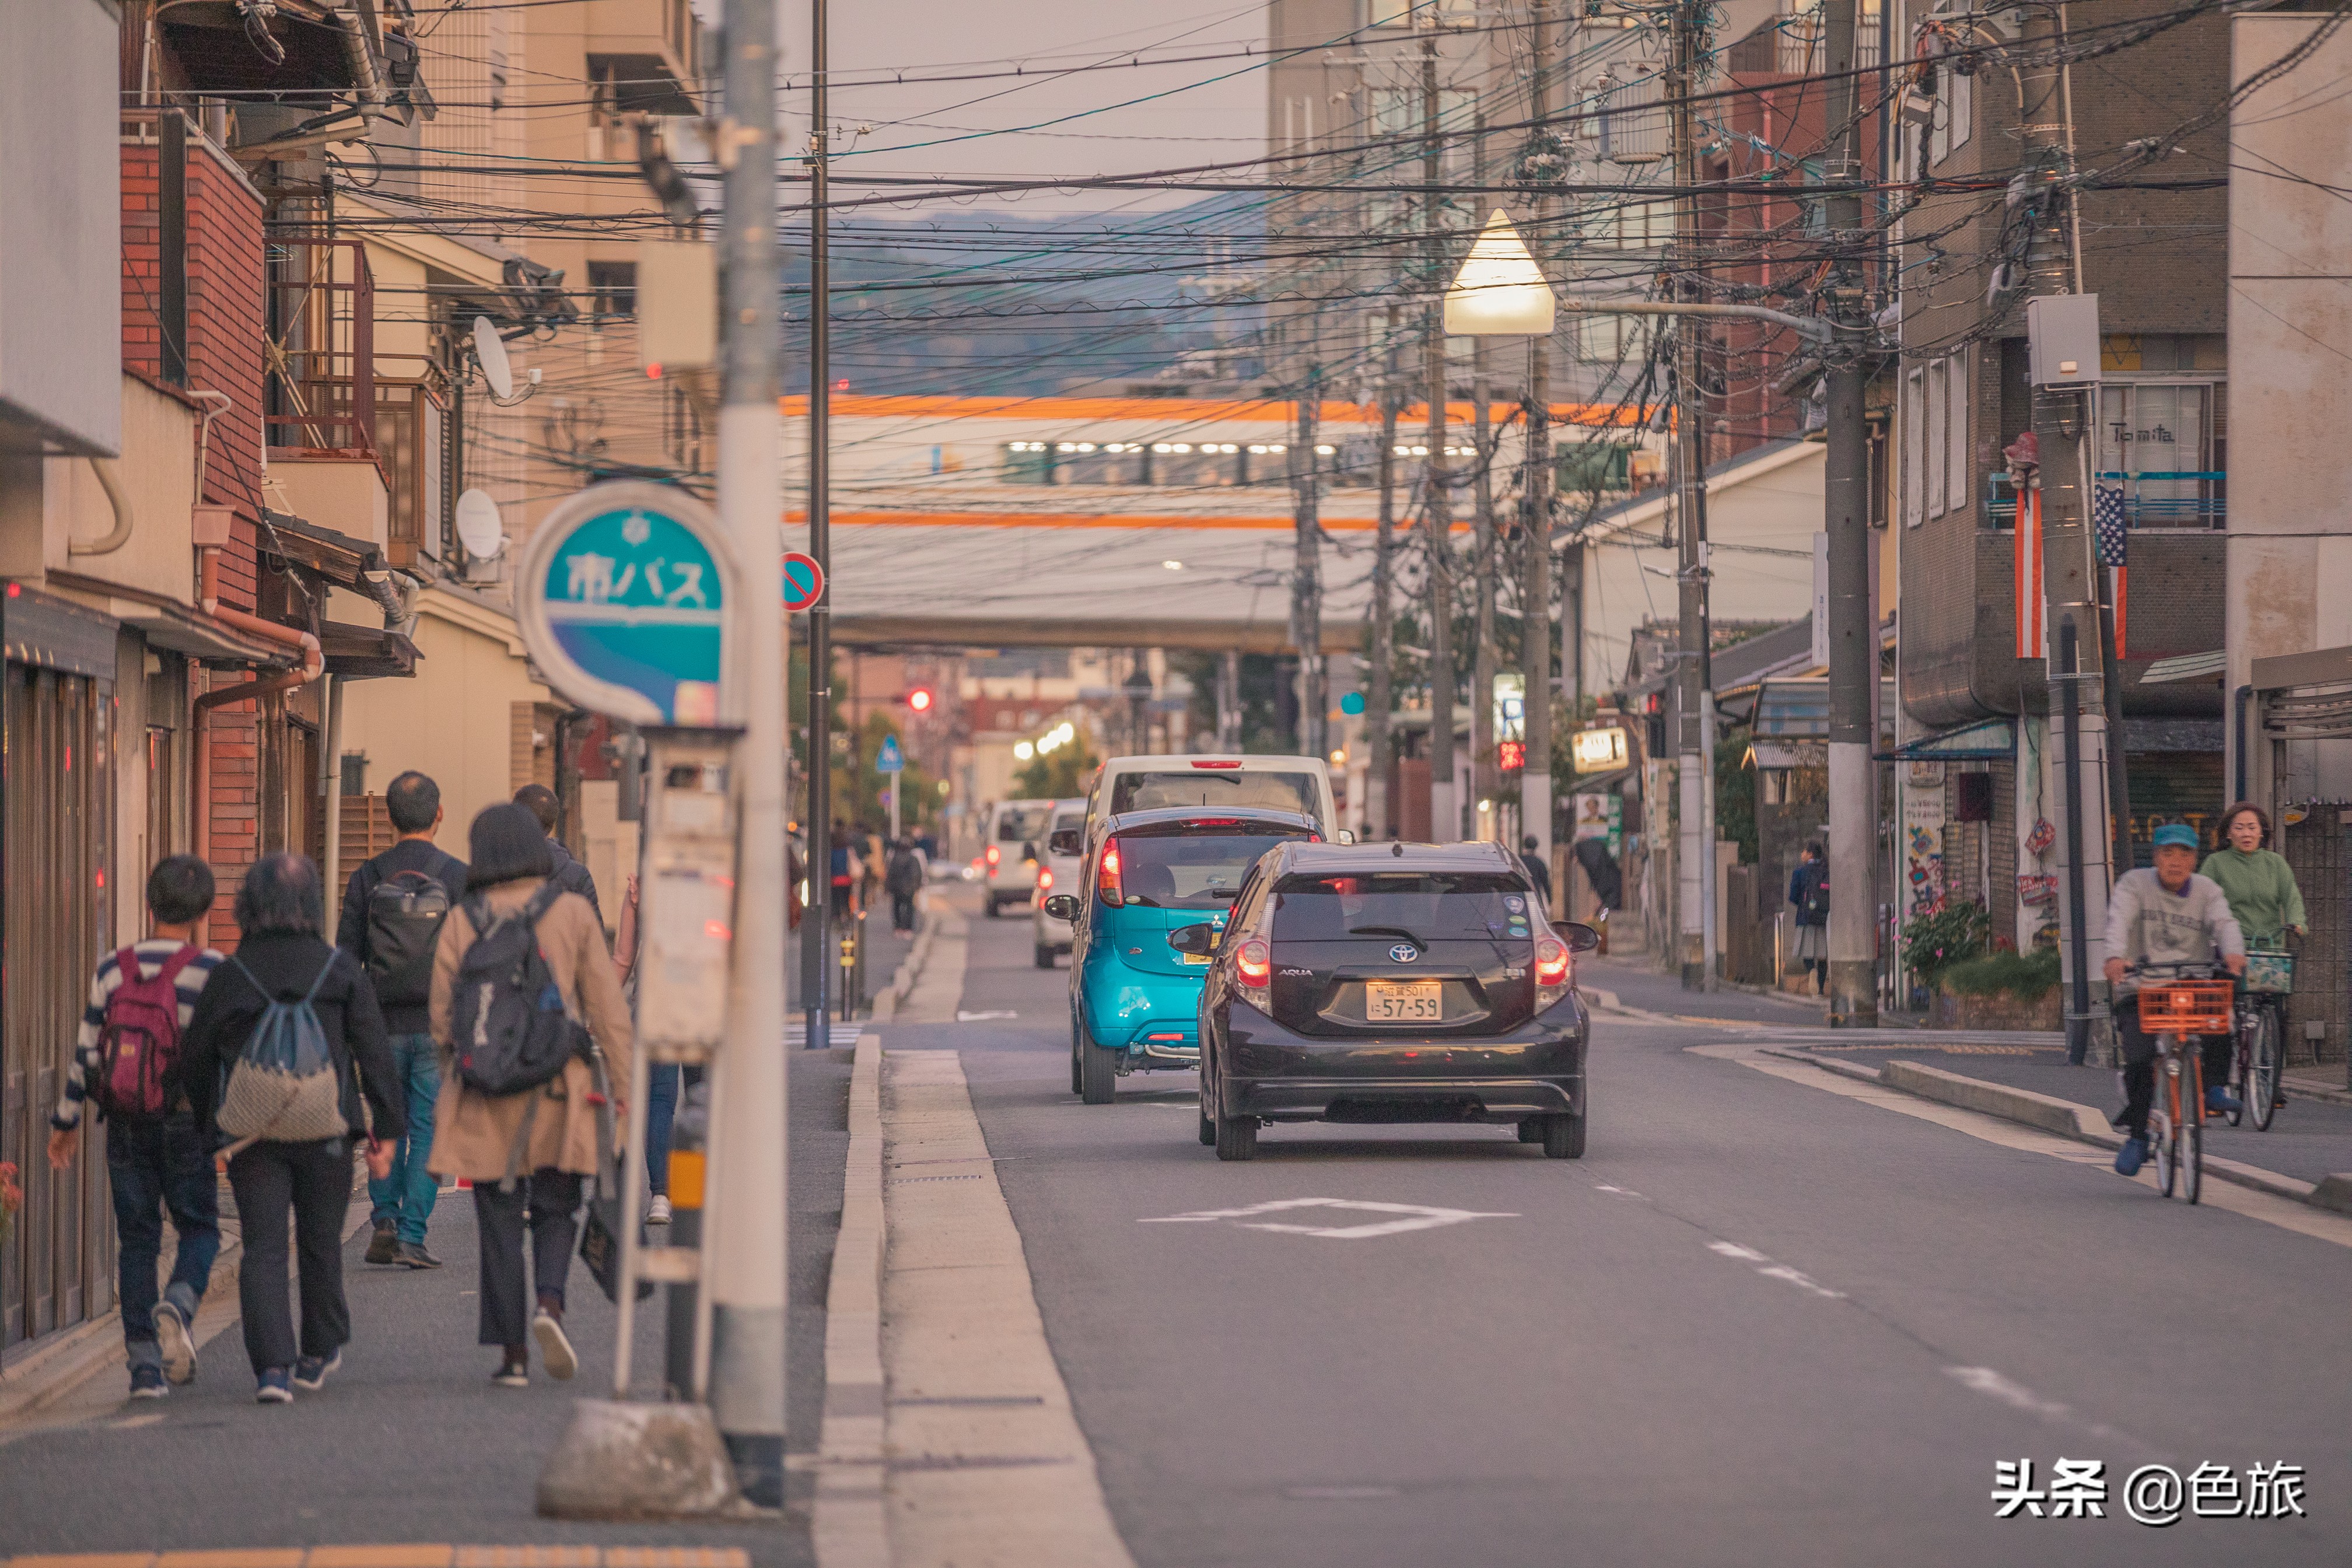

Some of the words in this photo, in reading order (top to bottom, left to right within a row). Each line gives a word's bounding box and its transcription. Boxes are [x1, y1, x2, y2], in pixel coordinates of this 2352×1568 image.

[2109, 422, 2175, 442] Tomita
[566, 551, 708, 607] 市バス
[1383, 999, 1437, 1017] 57-59
